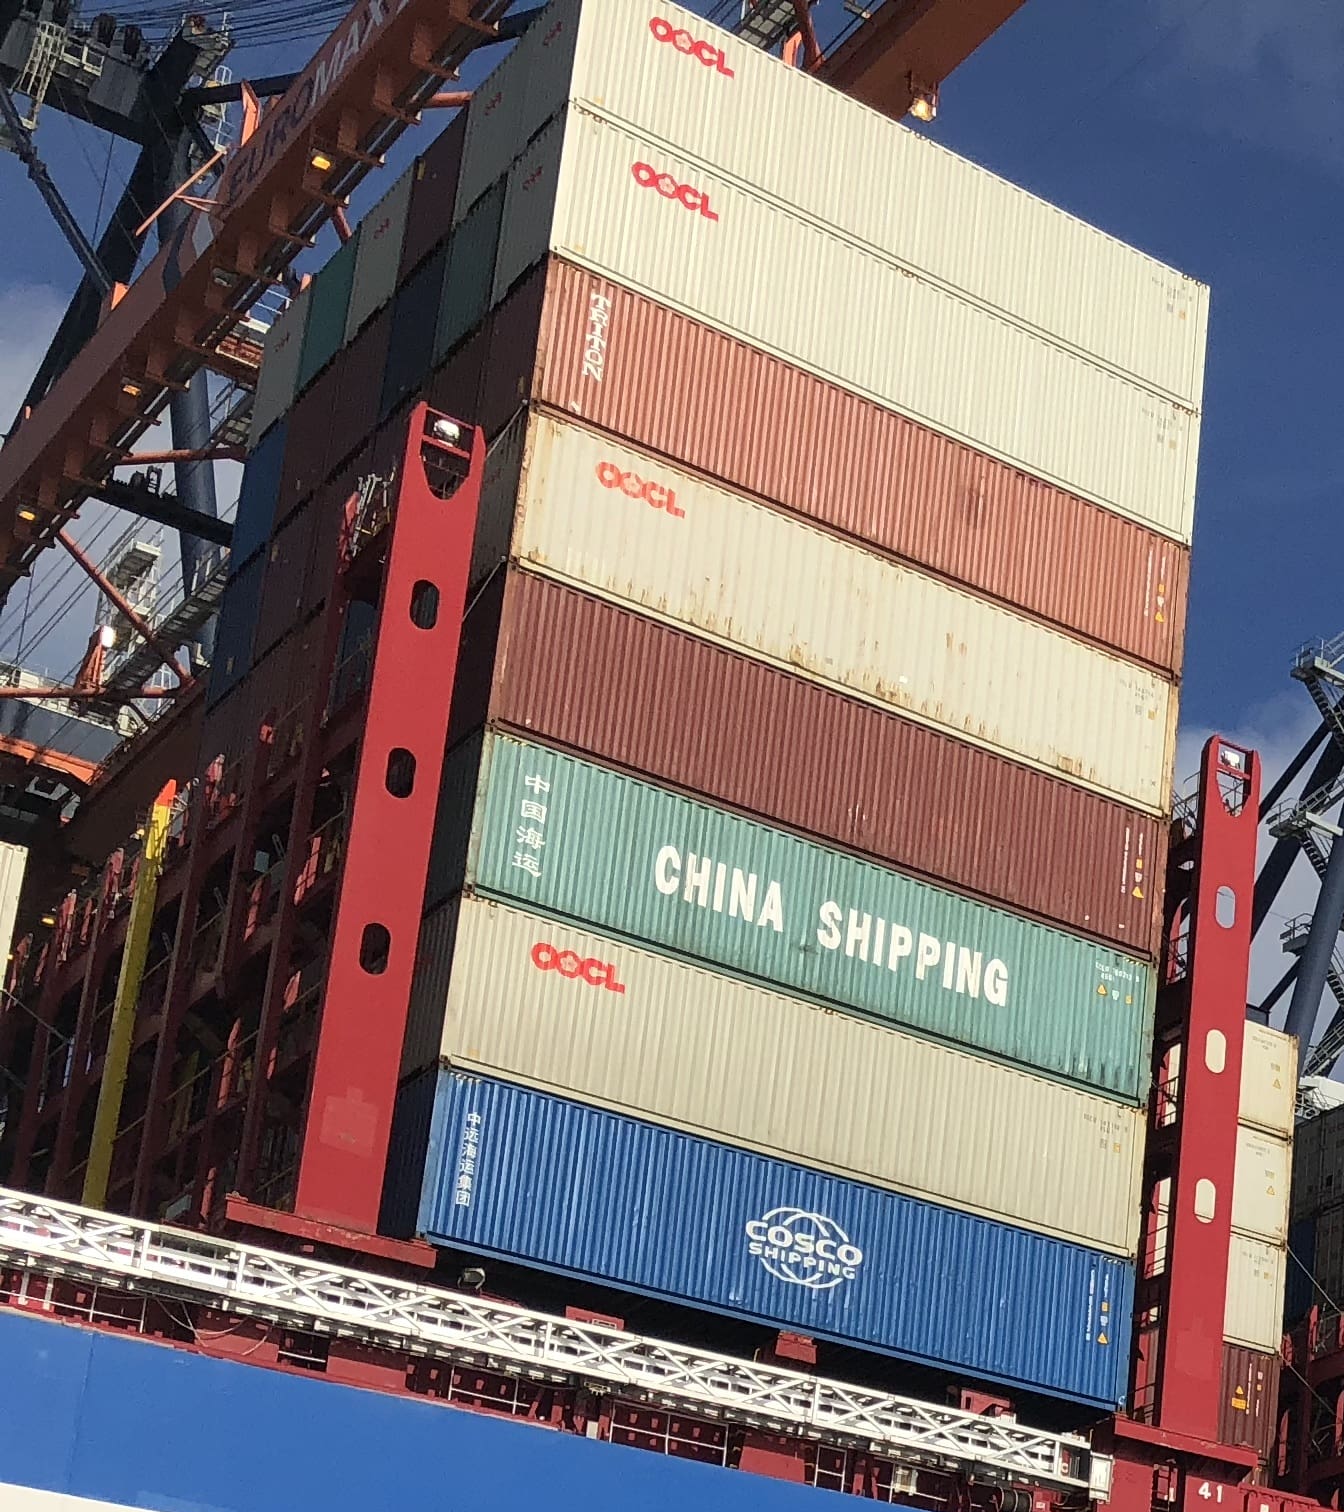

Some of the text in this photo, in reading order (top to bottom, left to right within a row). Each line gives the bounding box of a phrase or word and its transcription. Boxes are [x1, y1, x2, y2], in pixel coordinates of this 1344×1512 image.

[649, 16, 735, 79] OOCL
[631, 161, 719, 222] OOCL
[581, 294, 612, 382] TRITON
[595, 461, 686, 519] OOCL
[512, 774, 551, 879] 中国海运
[655, 845, 1009, 1008] CHINA SHIPPING
[531, 942, 626, 994] OOCL
[745, 1220, 863, 1266] COSCO
[748, 1241, 856, 1280] SHIPPING
[1198, 1482, 1224, 1503] 41
